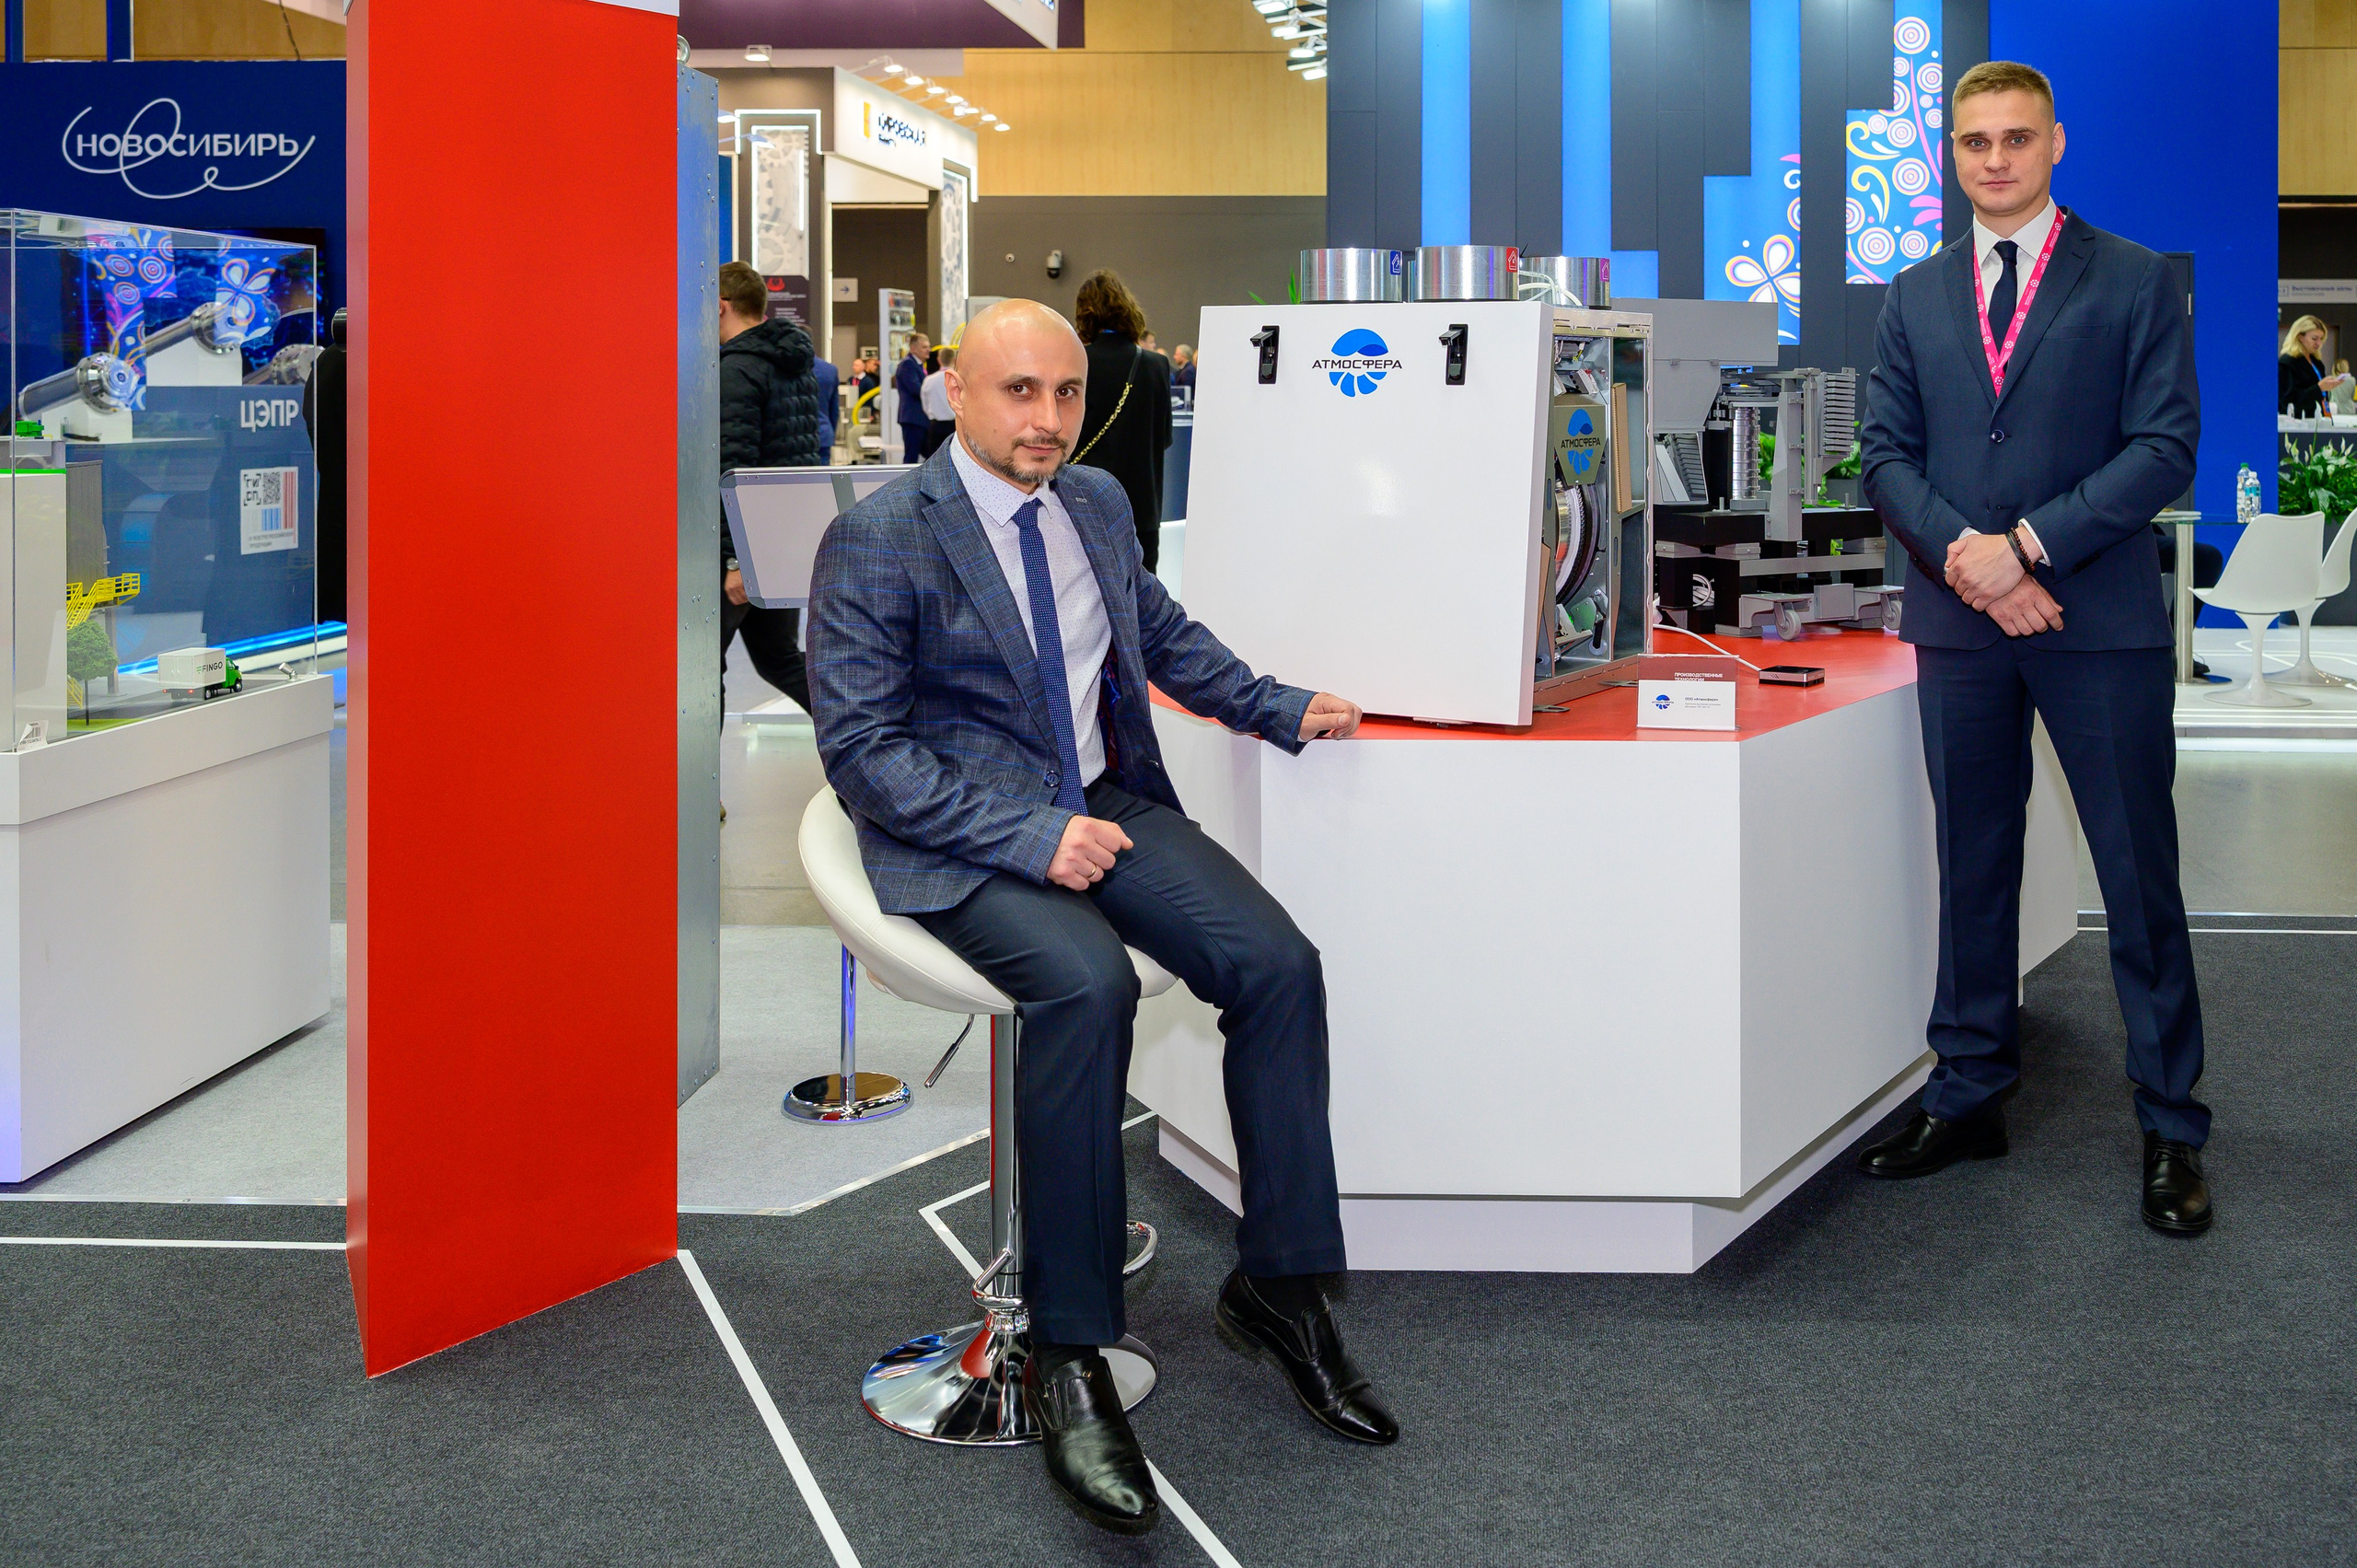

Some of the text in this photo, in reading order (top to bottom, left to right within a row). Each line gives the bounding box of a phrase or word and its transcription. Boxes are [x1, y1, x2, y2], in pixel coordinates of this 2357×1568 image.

[76, 134, 300, 157] НОВОСИБИРЬ
[1311, 359, 1403, 369] АТМОСФЕРА
[240, 399, 300, 433] ЦЭПР
[1560, 436, 1601, 449] АТМОСФЕРА
[202, 661, 224, 673] FINGO
